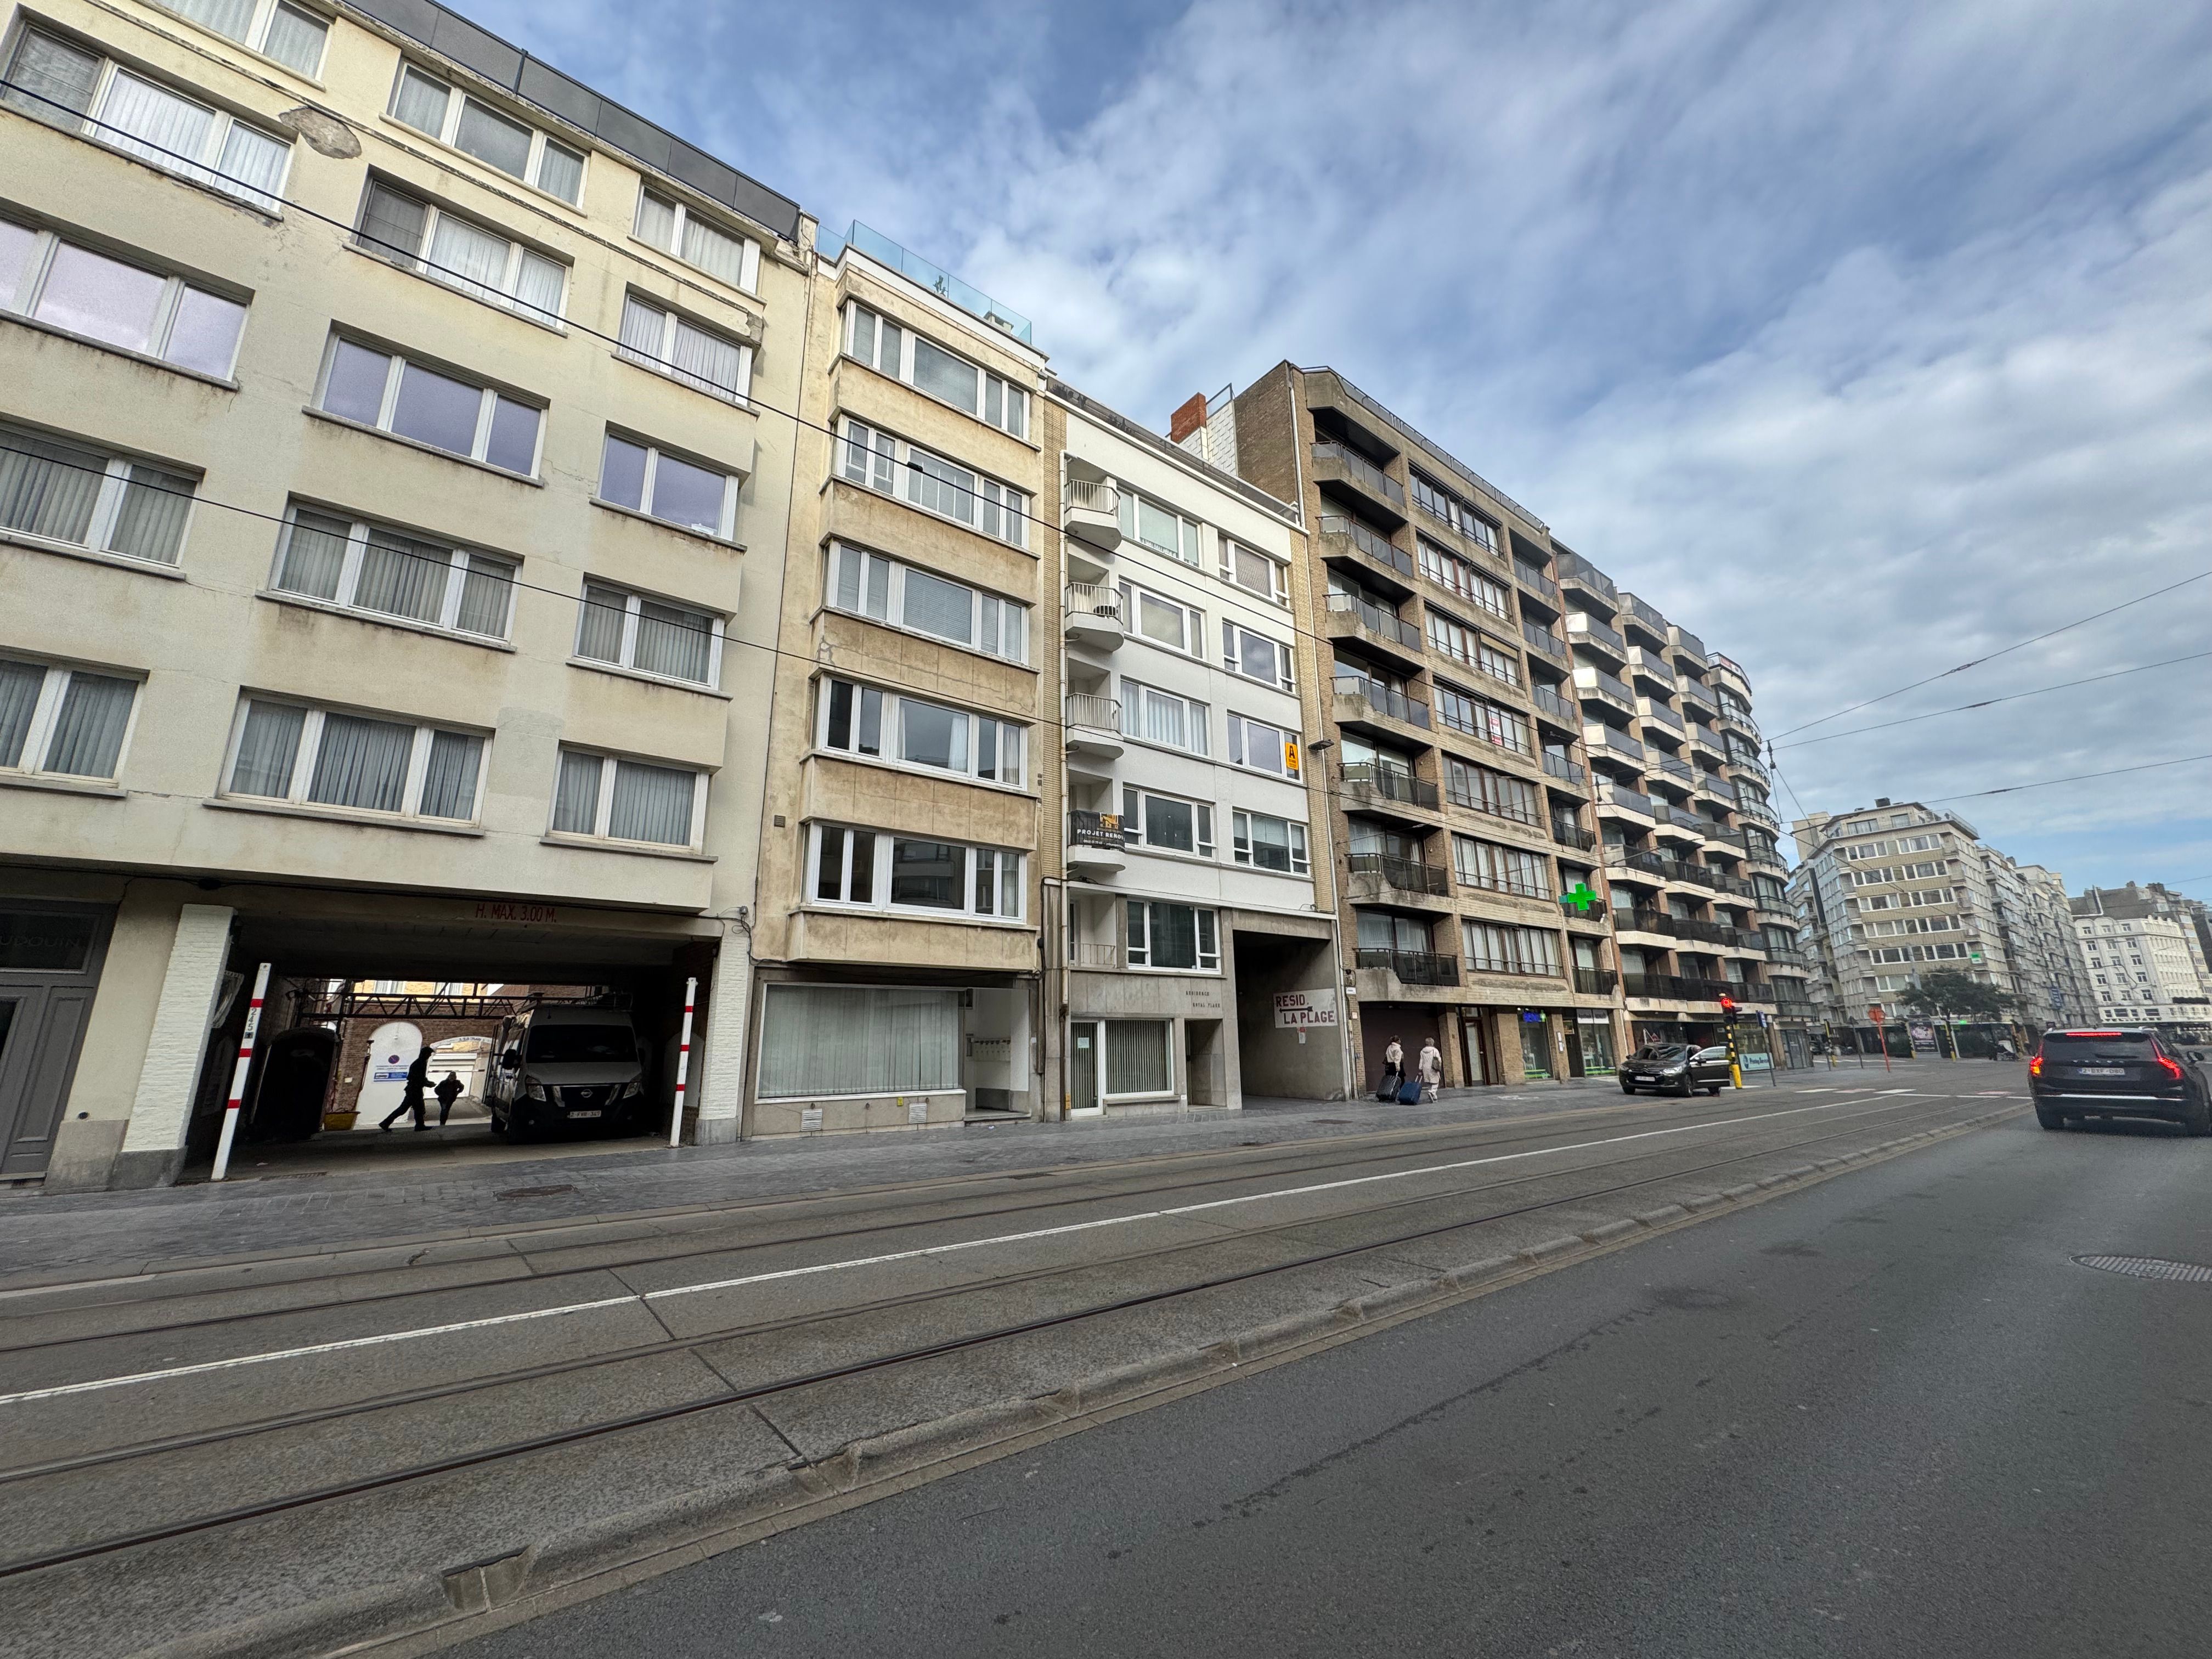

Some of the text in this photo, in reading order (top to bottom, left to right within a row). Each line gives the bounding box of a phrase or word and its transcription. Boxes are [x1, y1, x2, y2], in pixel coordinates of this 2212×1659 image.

[475, 903, 557, 923] H. MAX. 3.00 M.
[1276, 994, 1309, 1007] RESID.
[247, 1008, 257, 1031] 245
[1284, 1011, 1335, 1024] LA PLAGE
